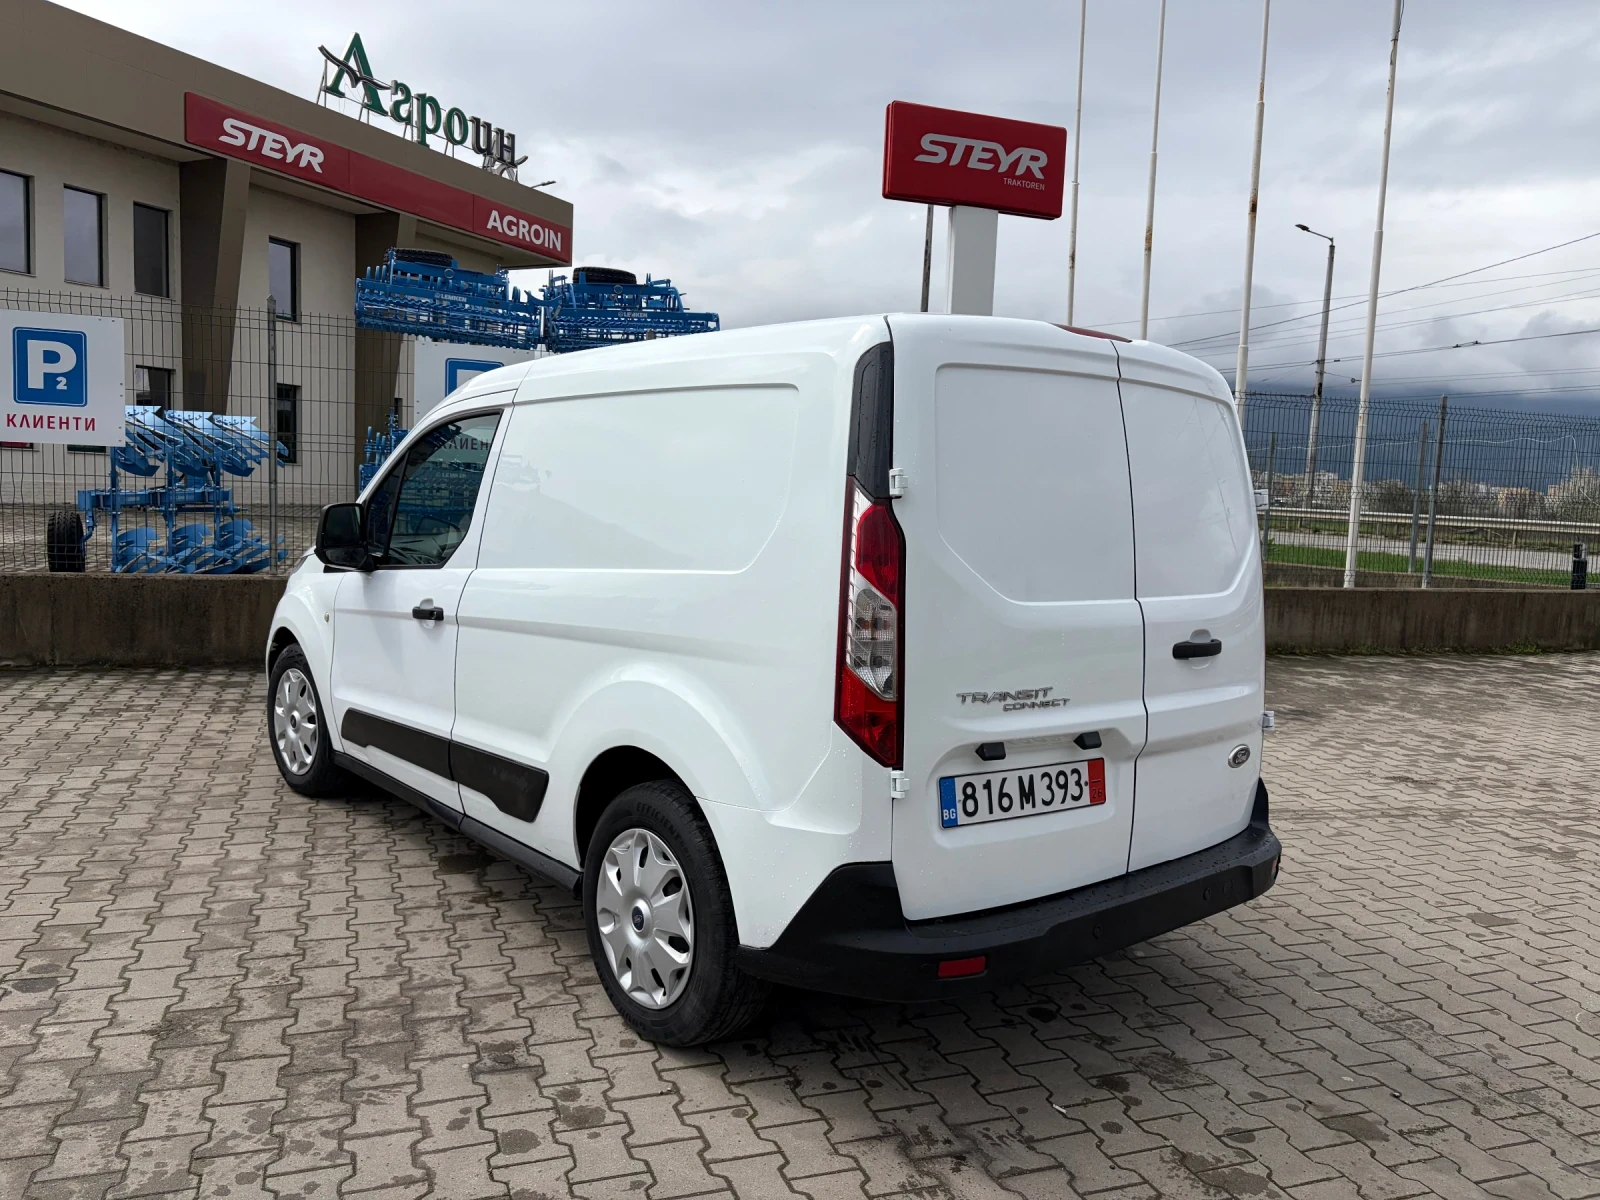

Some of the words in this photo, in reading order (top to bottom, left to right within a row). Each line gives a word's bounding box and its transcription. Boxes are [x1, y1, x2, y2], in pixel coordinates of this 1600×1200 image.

[219, 118, 325, 173] STEYR
[914, 133, 1048, 179] STEYR
[1003, 177, 1045, 191] TRAKTOREN
[486, 209, 562, 252] AGROIN
[6, 413, 96, 431] КЛИЕНТИ
[956, 686, 1053, 704] TRANSIT
[1002, 698, 1070, 712] CONNECT
[943, 809, 957, 820] BG
